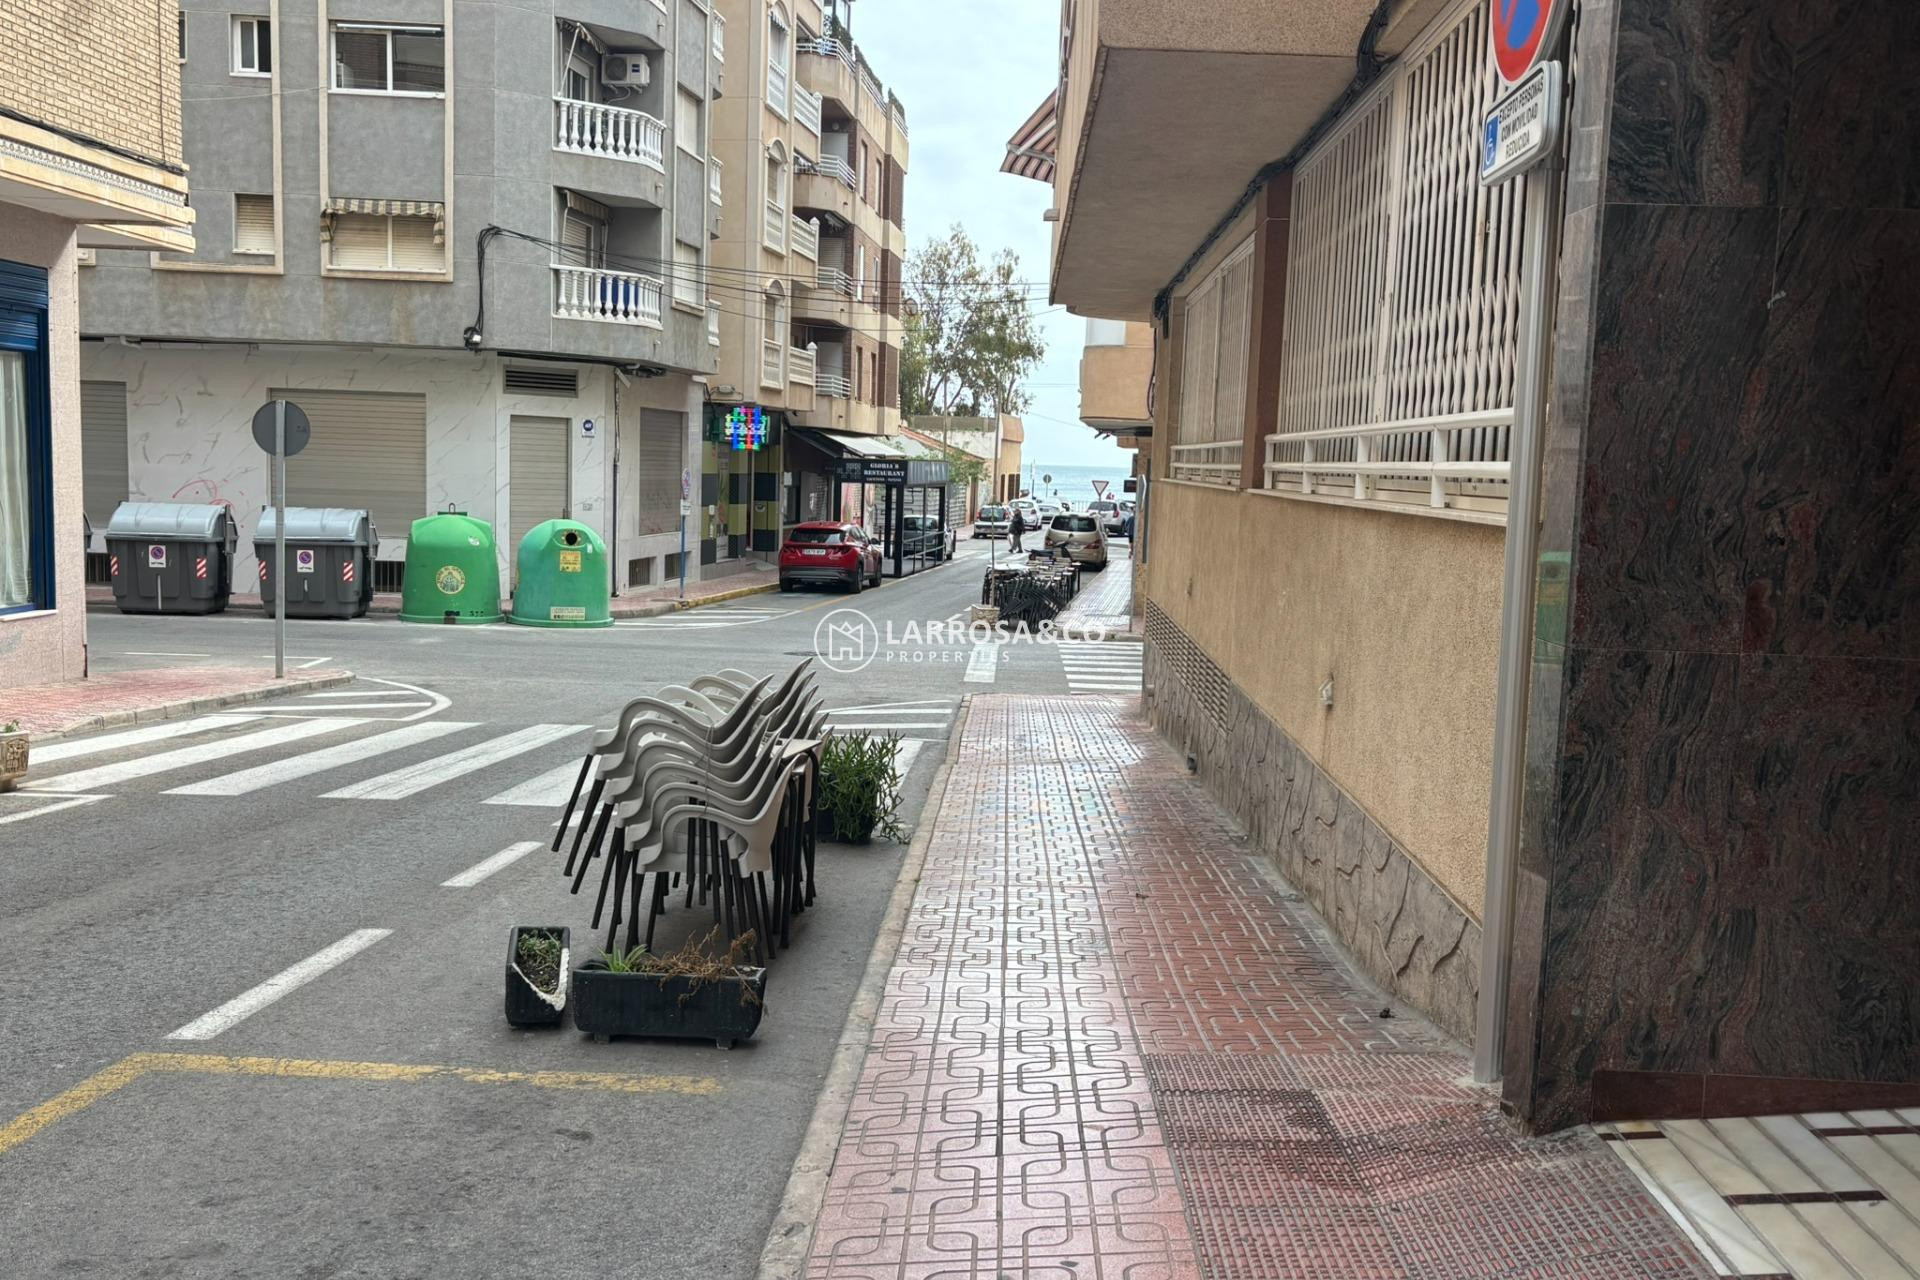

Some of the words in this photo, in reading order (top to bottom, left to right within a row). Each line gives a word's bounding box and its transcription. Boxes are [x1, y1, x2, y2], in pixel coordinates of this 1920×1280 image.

[1498, 97, 1518, 124] EXCEPTO
[1518, 76, 1544, 110] PERSONAS
[1501, 122, 1511, 142] CON
[1511, 102, 1538, 135] MOVILIDAD
[1505, 129, 1530, 159] REDUCIDA
[863, 469, 905, 477] RESTAURANT
